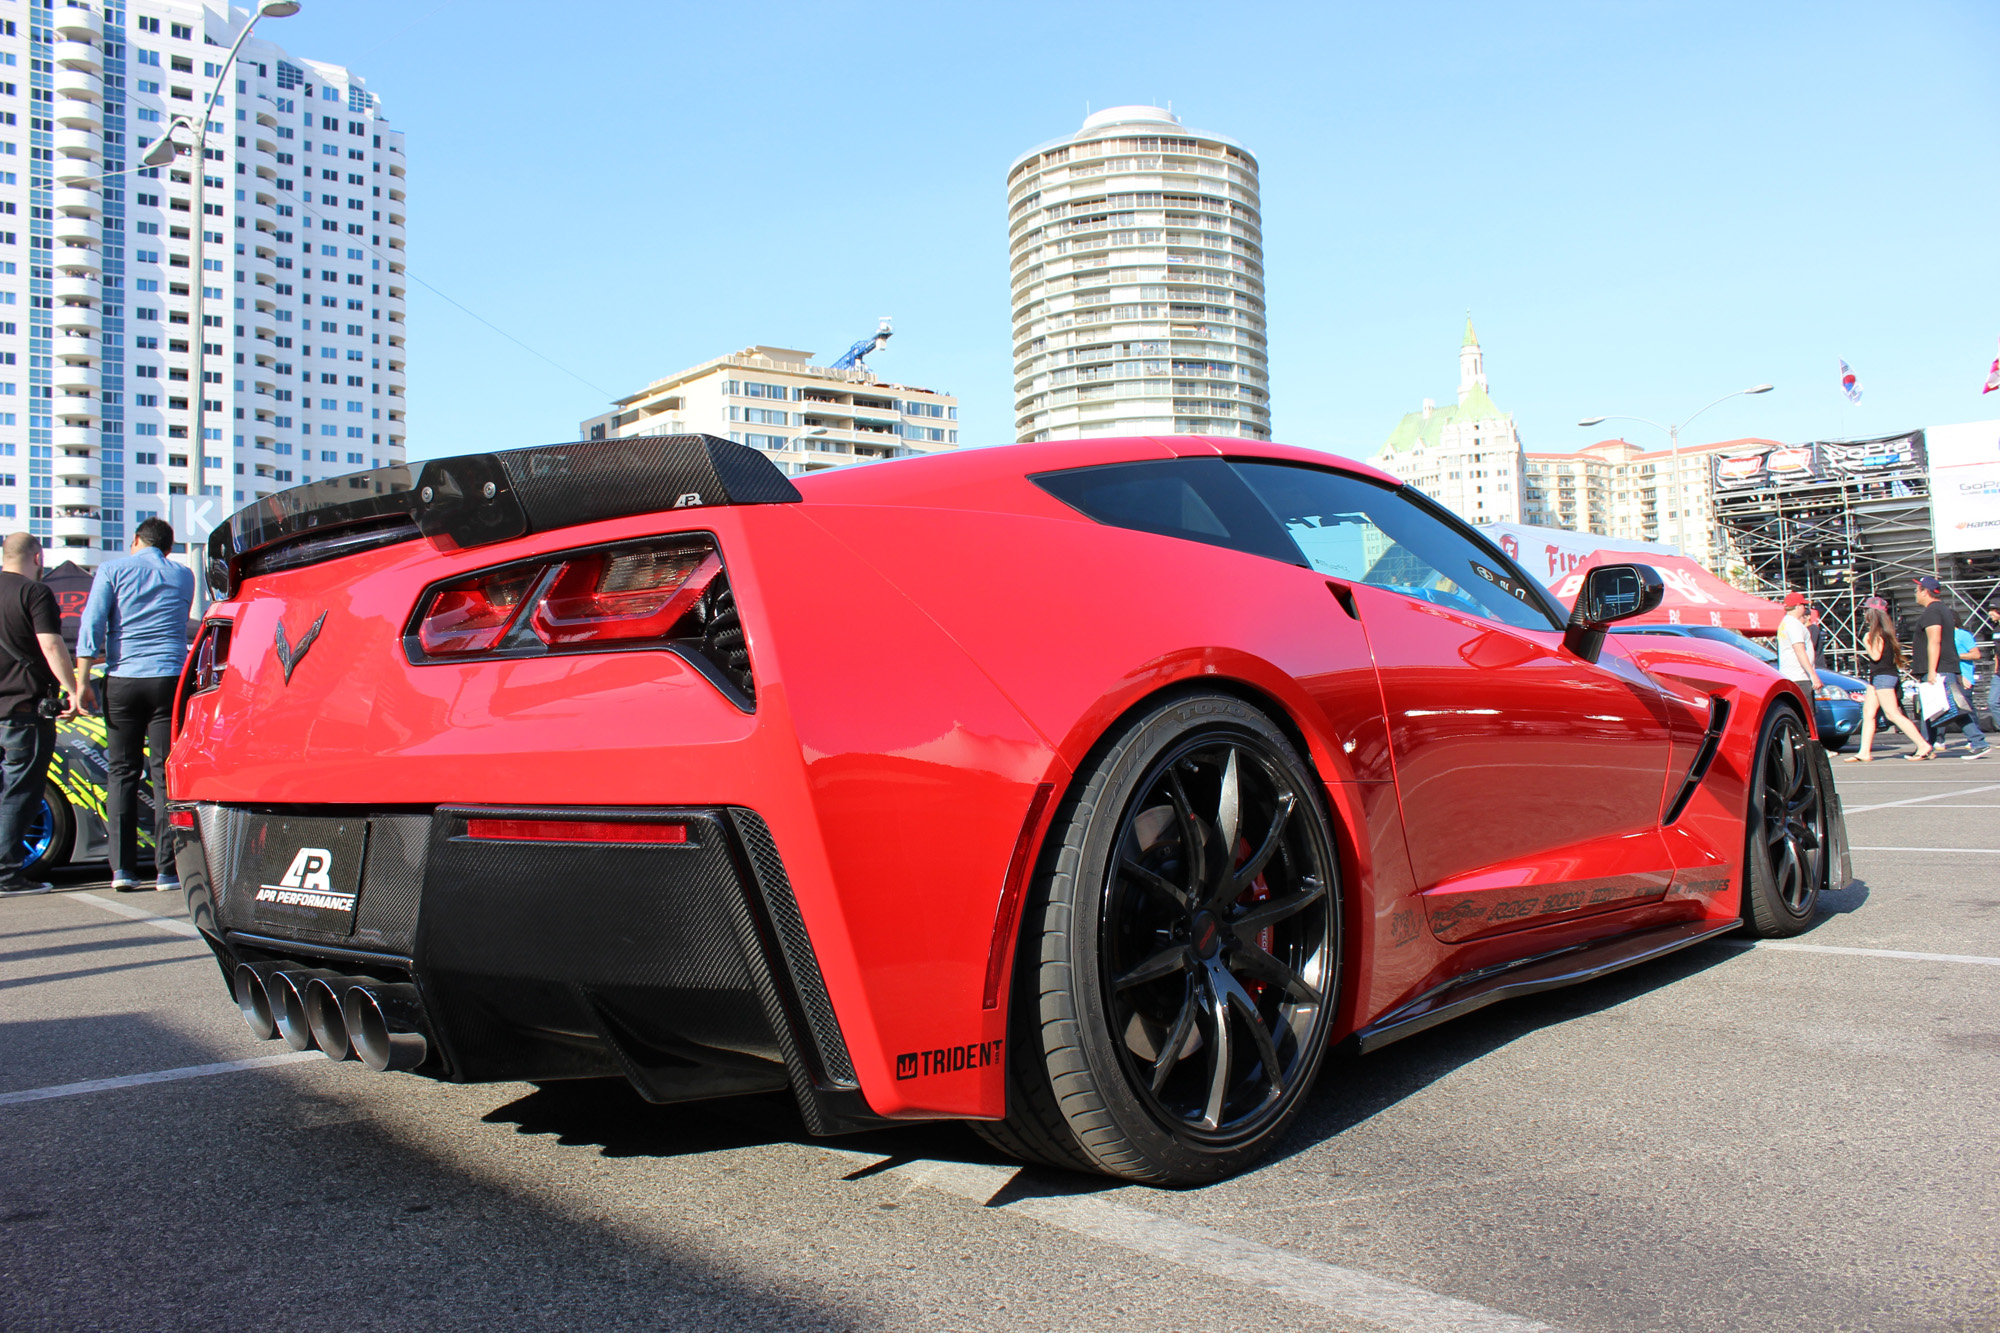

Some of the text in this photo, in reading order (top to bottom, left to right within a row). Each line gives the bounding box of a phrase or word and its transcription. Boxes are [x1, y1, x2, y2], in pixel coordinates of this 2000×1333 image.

[186, 499, 214, 536] K
[1177, 702, 1246, 721] TOYO
[255, 888, 355, 912] APR PERFORMANCE
[921, 1039, 1003, 1076] TRIDENT
